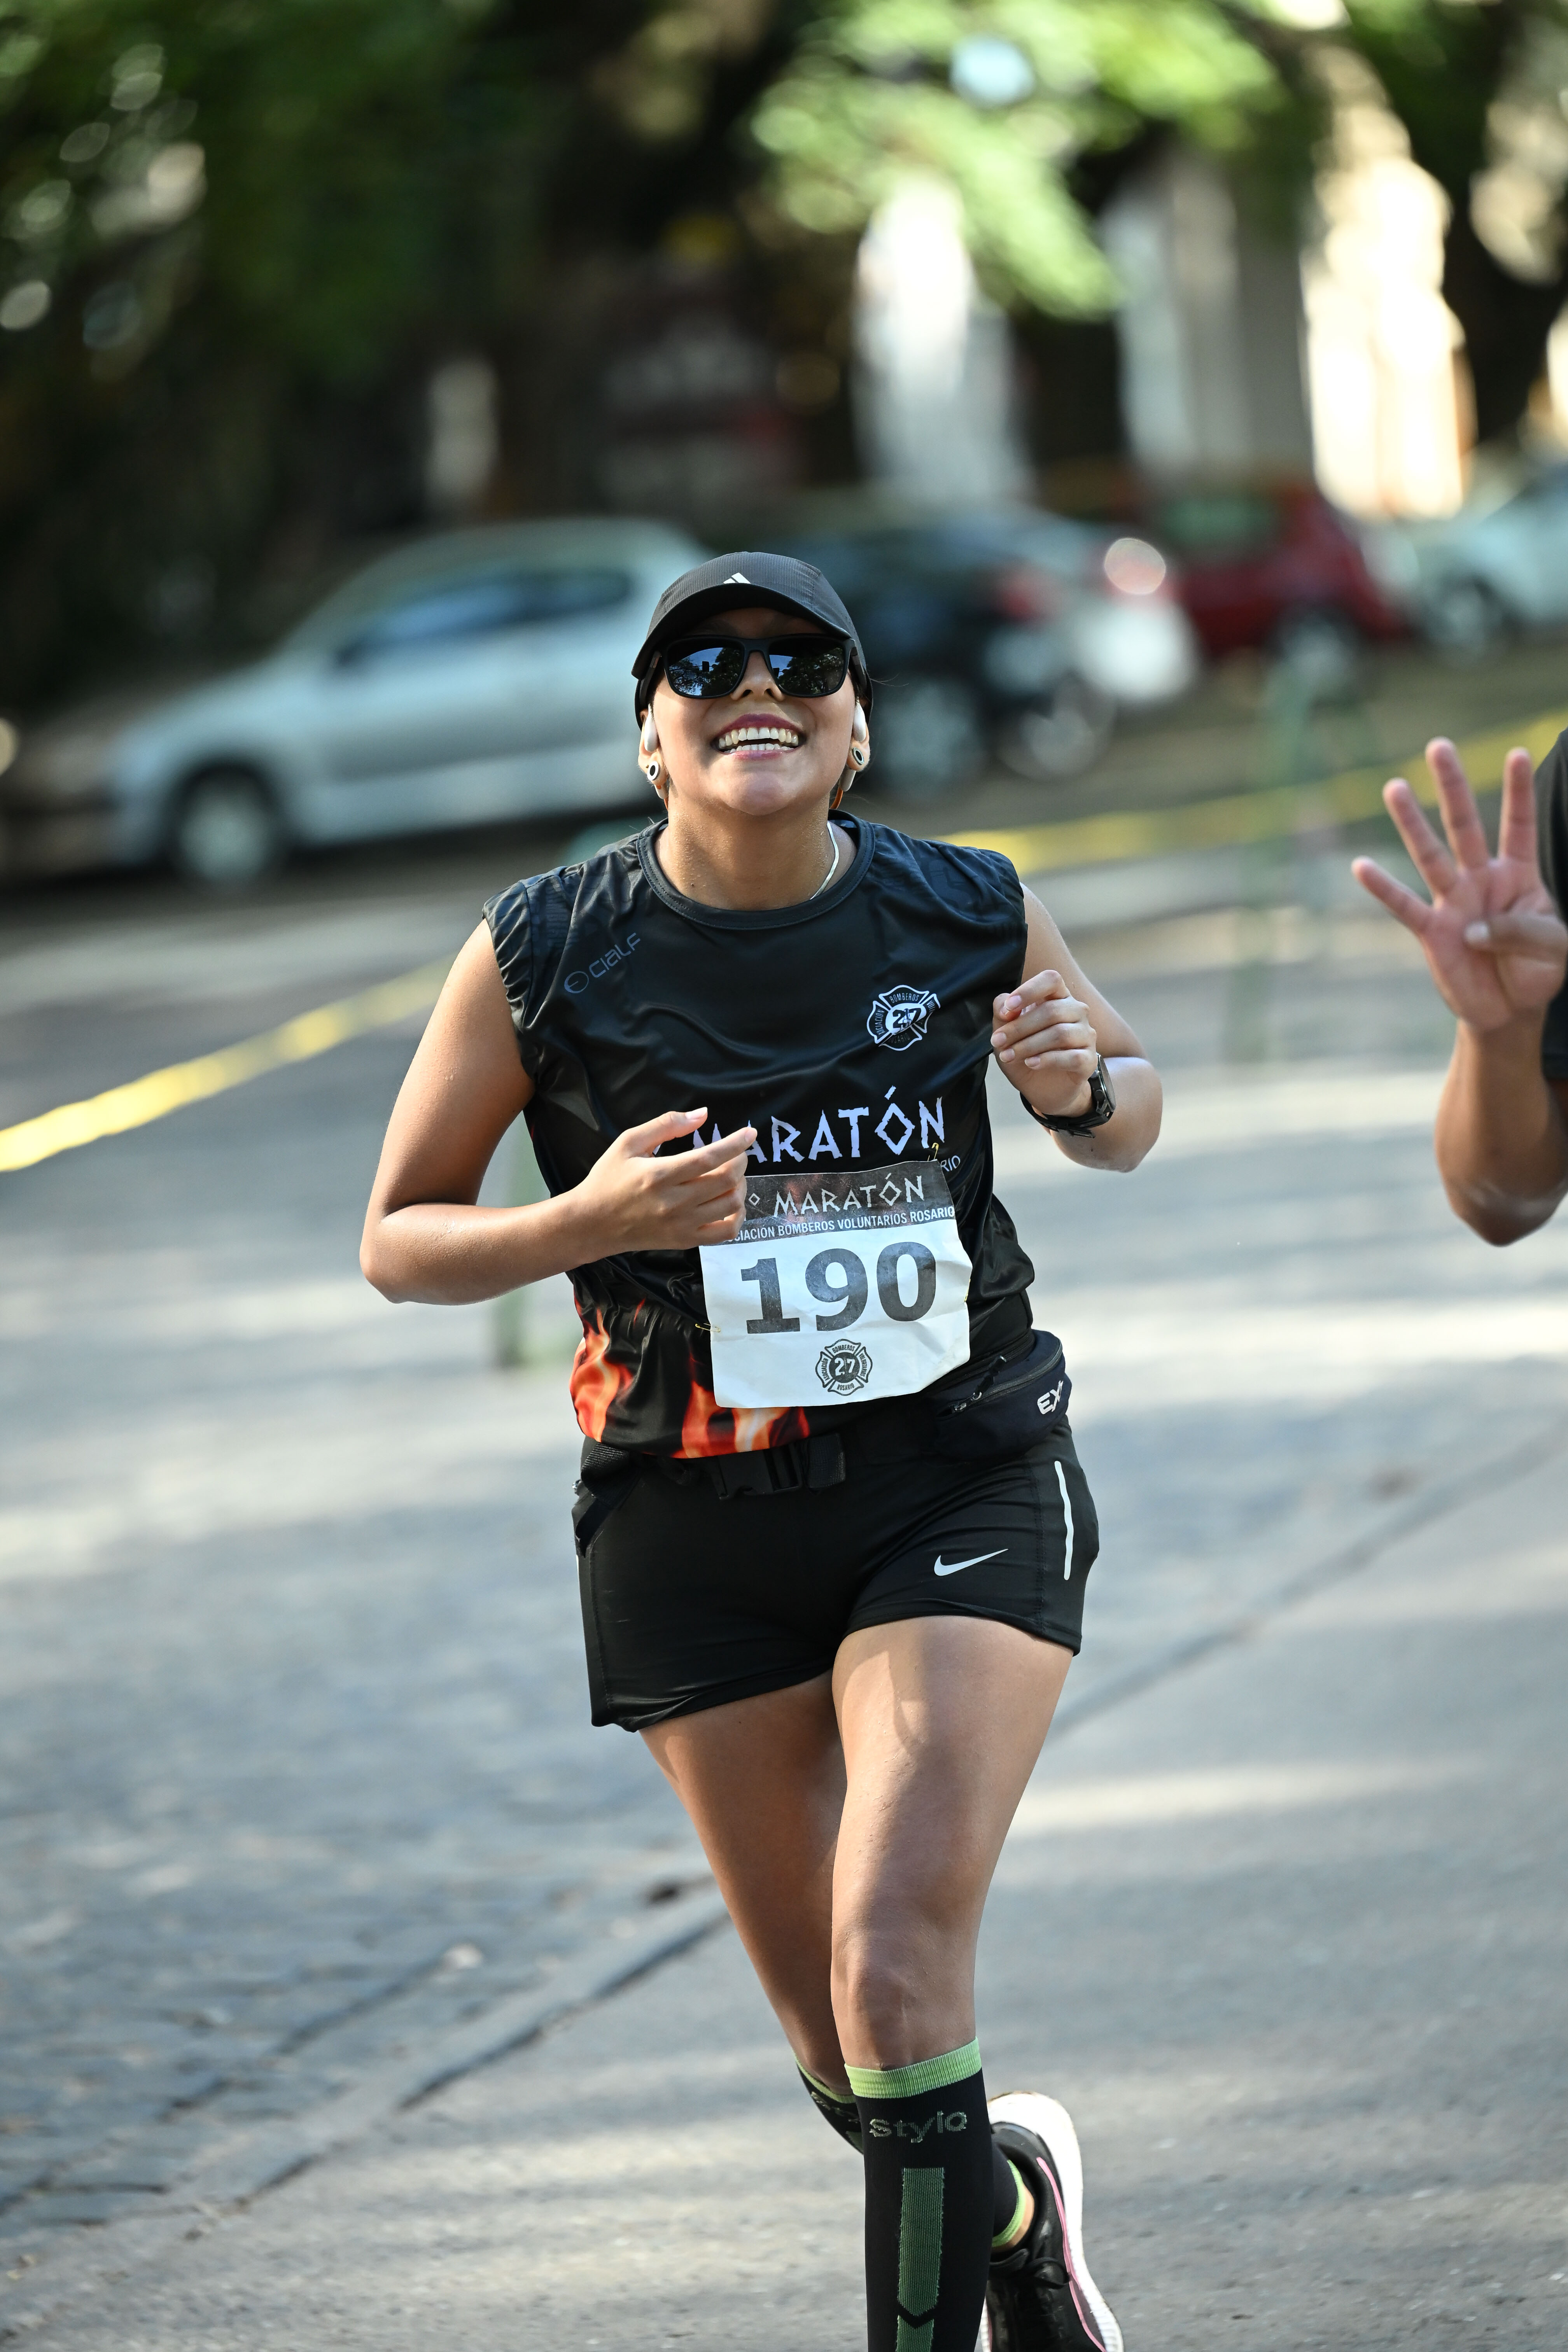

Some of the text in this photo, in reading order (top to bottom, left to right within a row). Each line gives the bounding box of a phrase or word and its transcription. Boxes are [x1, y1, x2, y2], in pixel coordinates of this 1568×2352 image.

[889, 992, 919, 1003] BOMBEROS
[774, 1173, 924, 1218] MARATÓN
[778, 1220, 835, 1236] BOMBEROS
[837, 1212, 907, 1229] VOLUNTARIOS
[910, 1206, 956, 1223] ROSARIO
[740, 1242, 936, 1334] 190
[832, 1344, 855, 1353] BOMBEROS
[835, 1357, 855, 1376] 27
[836, 1382, 855, 1391] ROSARIO
